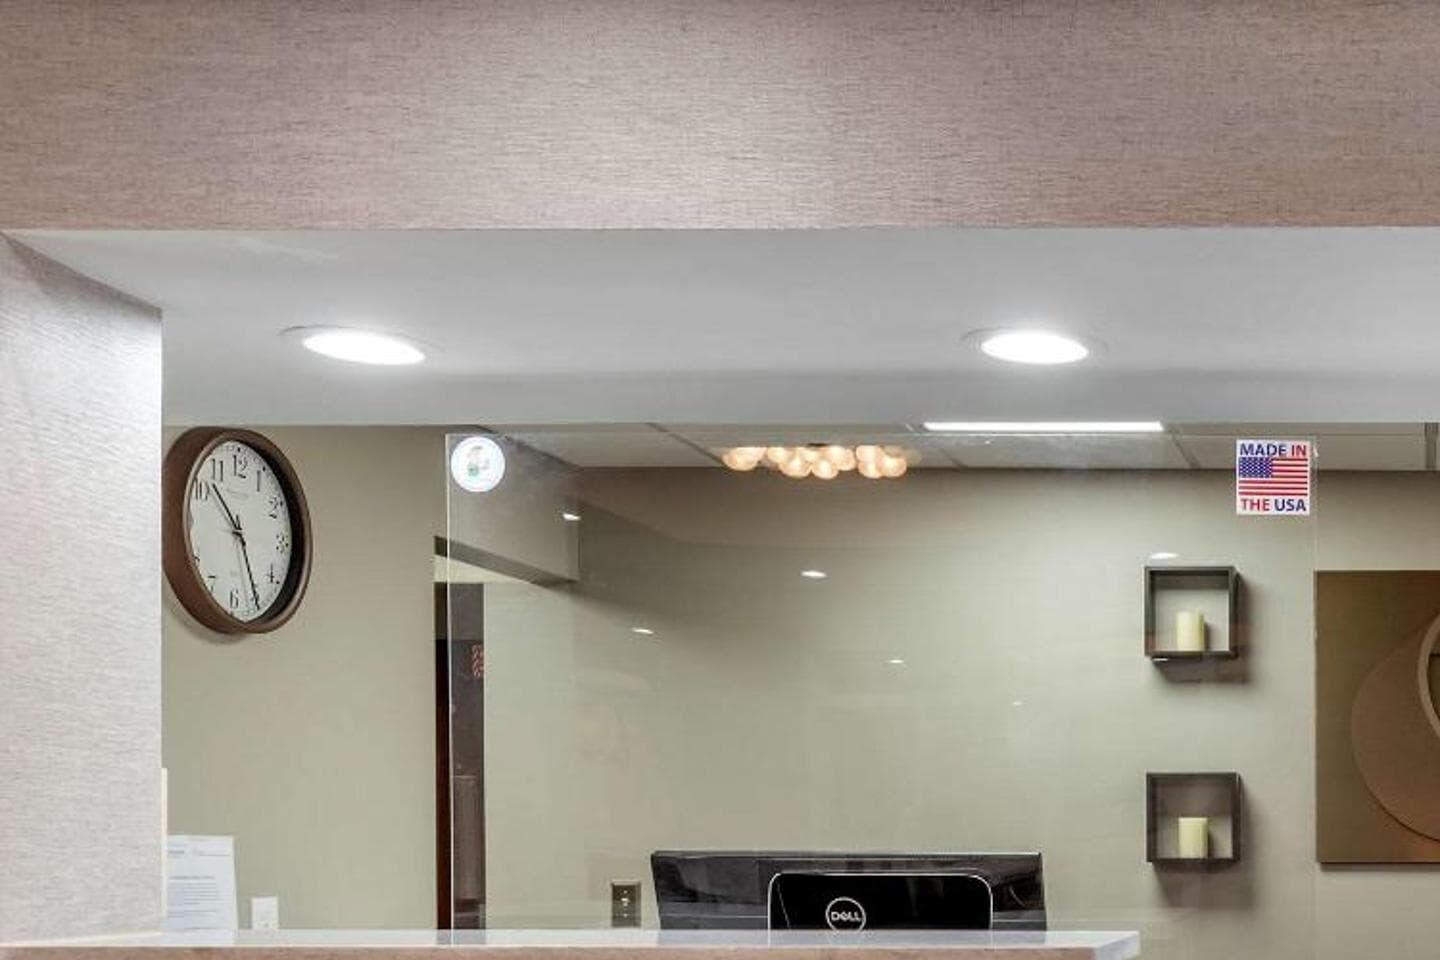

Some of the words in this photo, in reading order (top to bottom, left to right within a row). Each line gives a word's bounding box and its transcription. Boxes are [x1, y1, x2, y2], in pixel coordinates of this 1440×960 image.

[1240, 444, 1287, 456] MADE
[1291, 445, 1306, 456] IN
[211, 458, 224, 482] 11
[232, 454, 247, 479] 12
[1241, 499, 1270, 511] THE
[1274, 499, 1306, 511] USA
[831, 911, 861, 922] DELL
